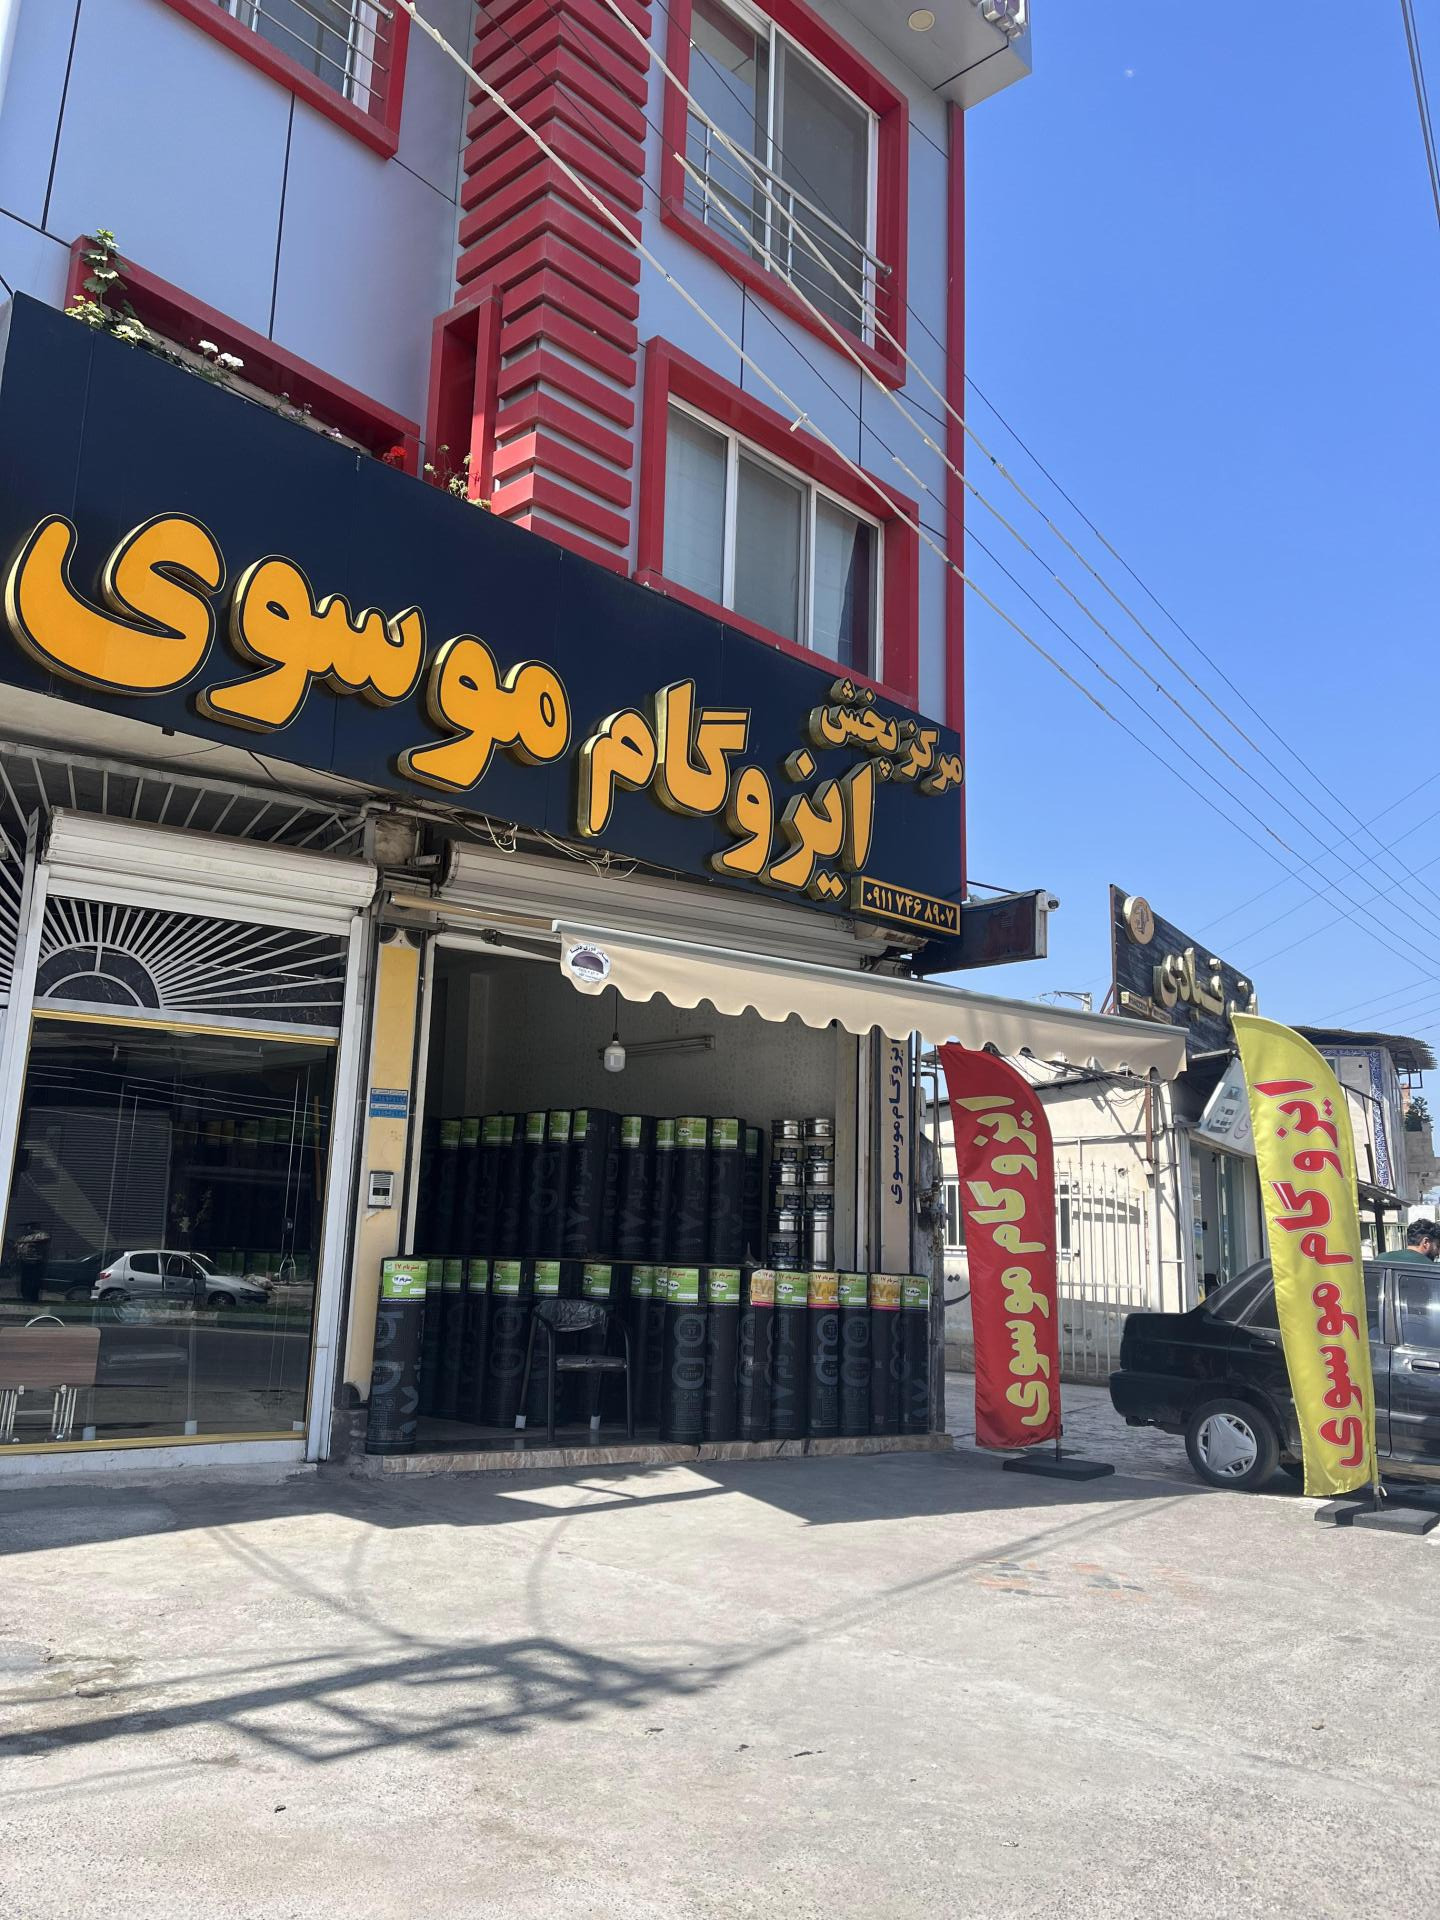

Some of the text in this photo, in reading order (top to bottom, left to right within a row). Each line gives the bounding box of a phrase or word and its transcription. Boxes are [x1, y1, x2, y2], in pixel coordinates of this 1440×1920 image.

[5, 511, 573, 793] موسوی
[809, 678, 965, 796] مرکز پخش
[890, 1120, 904, 1205] موسوی
[1001, 1265, 1050, 1427] موسوی
[1310, 1280, 1365, 1469] موسوی
